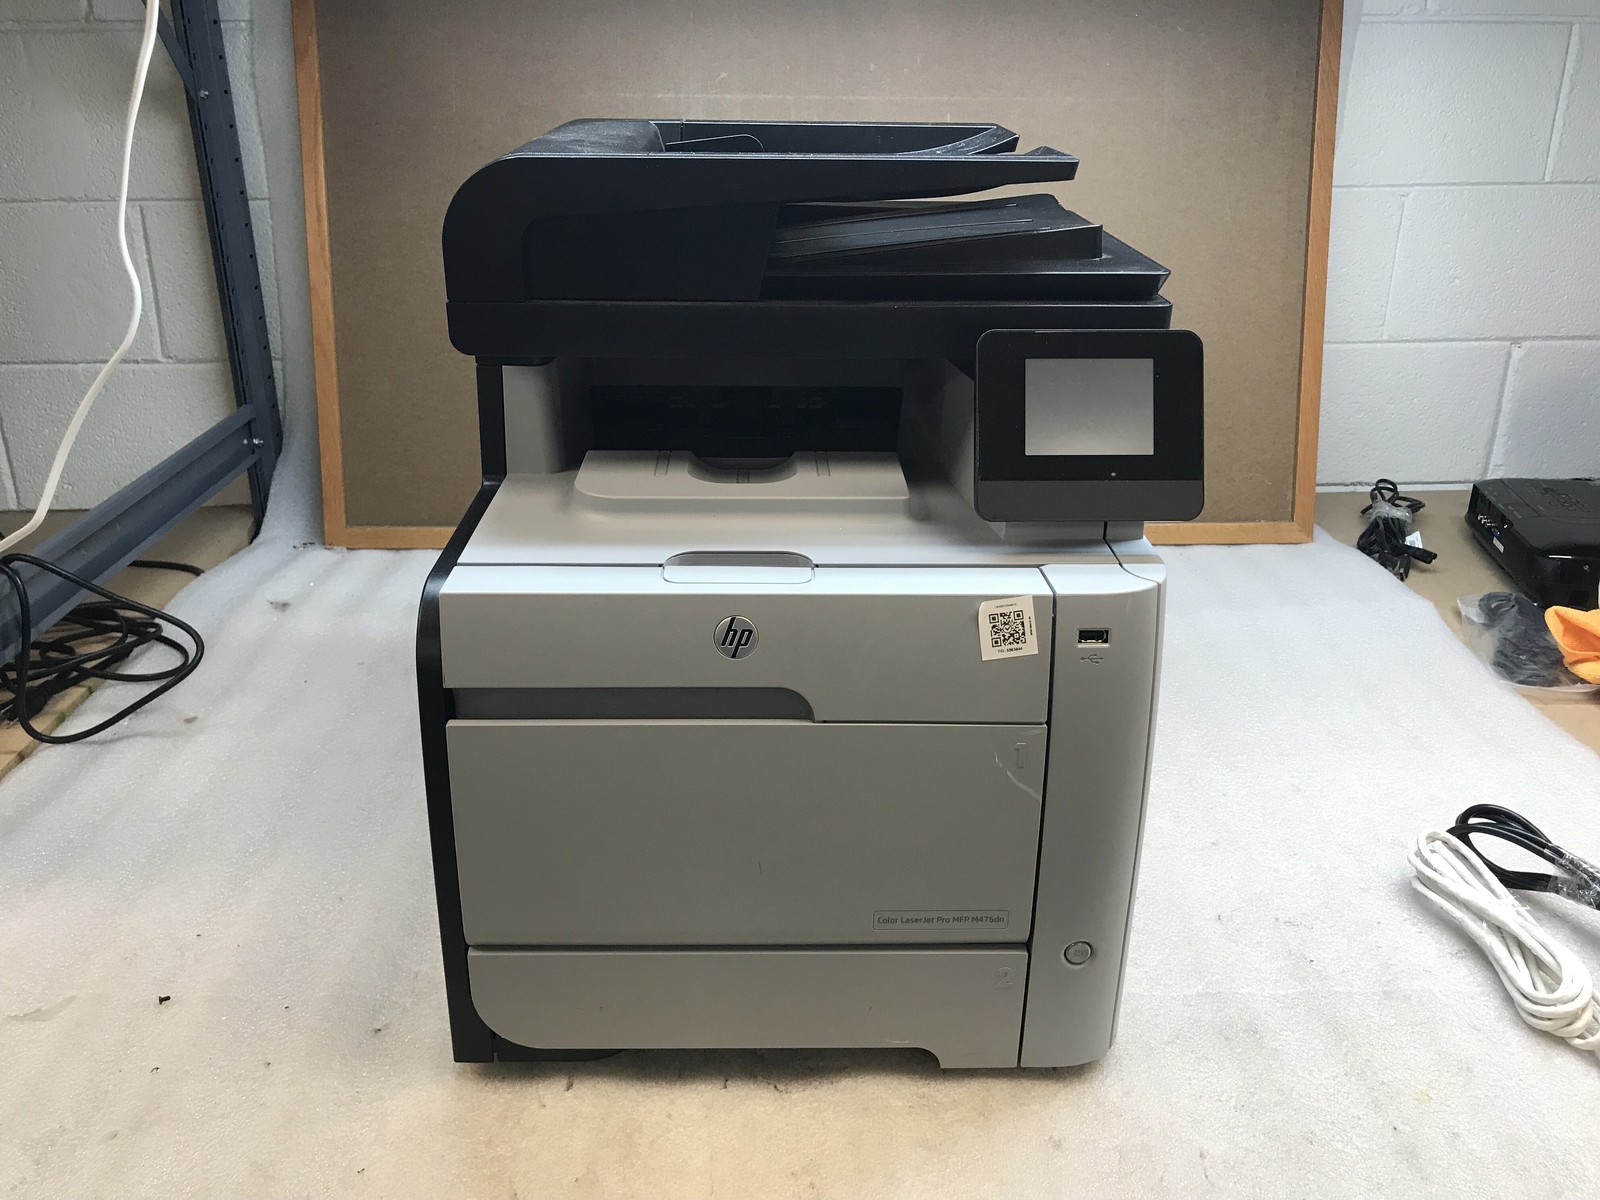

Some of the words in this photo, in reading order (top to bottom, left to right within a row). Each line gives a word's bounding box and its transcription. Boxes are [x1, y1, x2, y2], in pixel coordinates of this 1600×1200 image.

[720, 616, 754, 659] hp
[1013, 742, 1027, 769] 1
[877, 916, 898, 924] Color
[900, 916, 935, 924] LaserJet
[936, 916, 951, 924] Pro
[952, 915, 970, 924] MFP
[971, 915, 1005, 924] M476dn
